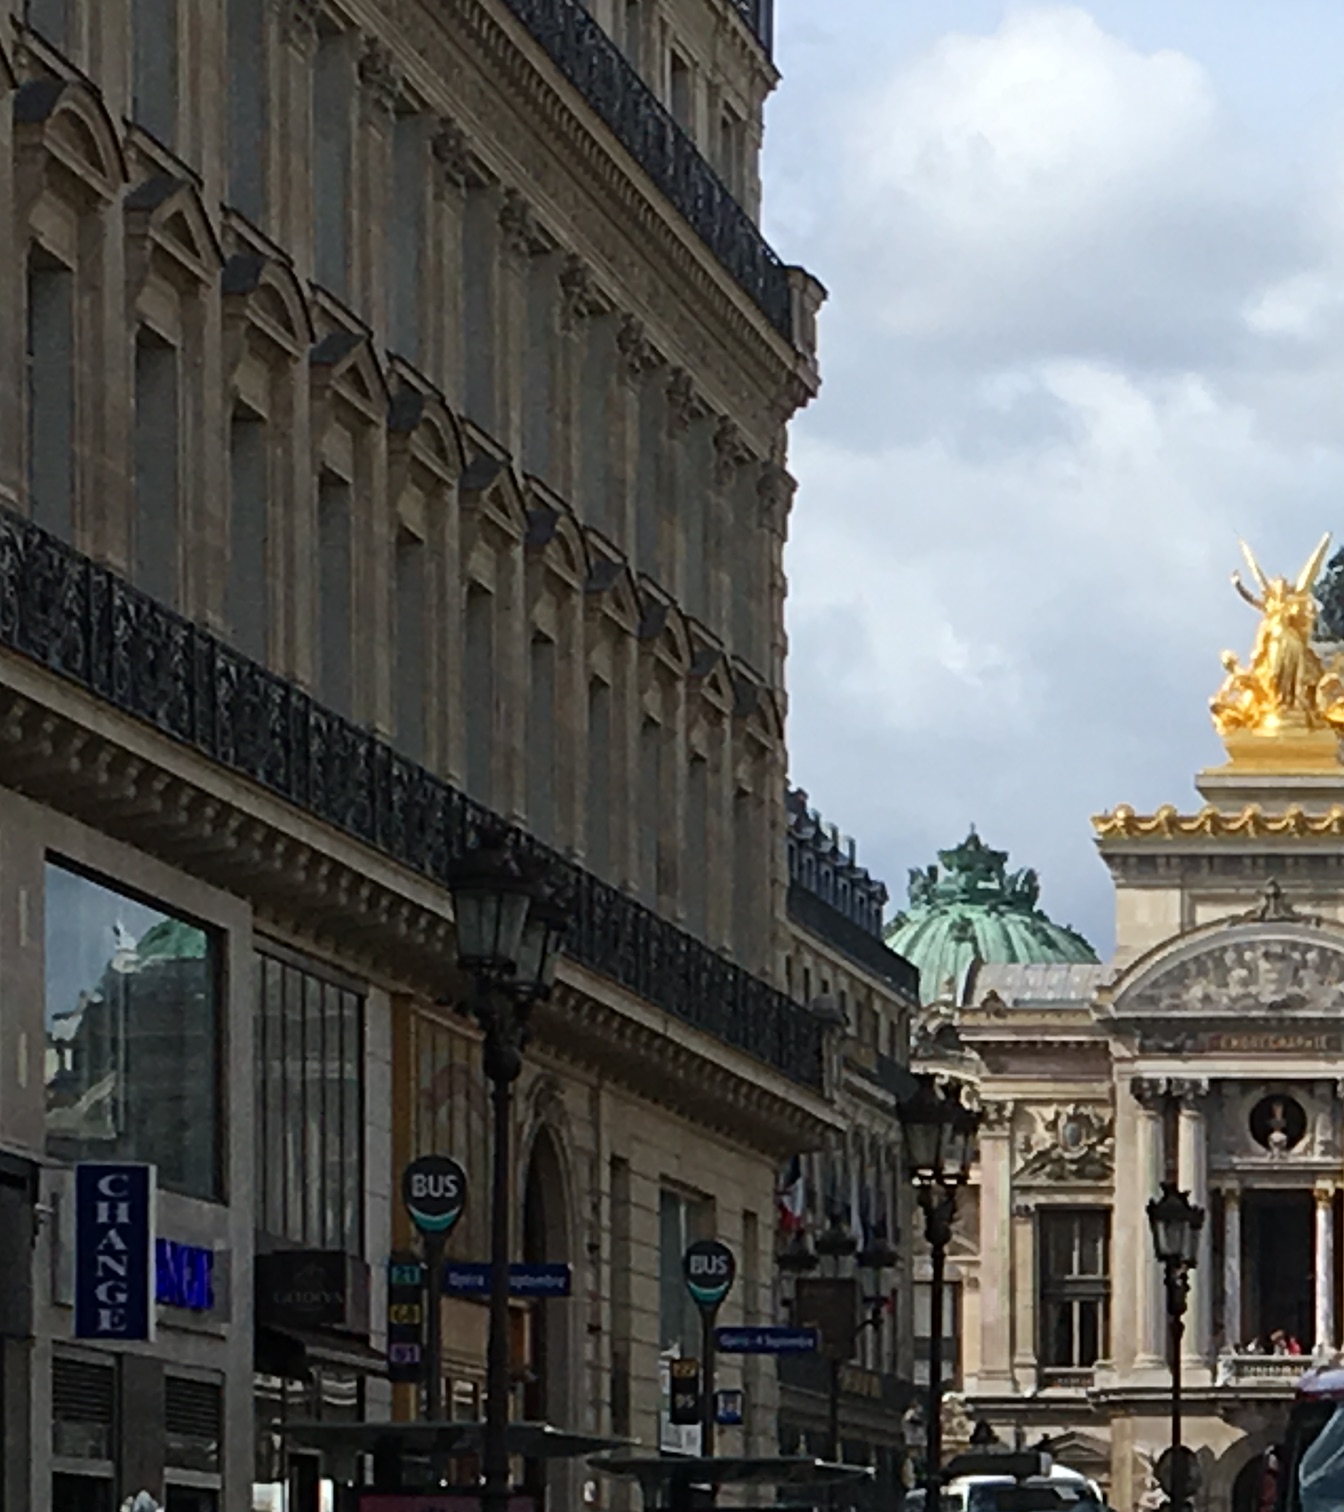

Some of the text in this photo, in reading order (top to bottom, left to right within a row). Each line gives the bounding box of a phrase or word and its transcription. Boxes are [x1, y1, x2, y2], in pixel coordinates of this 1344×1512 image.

[411, 1174, 459, 1199] BUS
[94, 1172, 132, 1333] CHANGE
[689, 1254, 728, 1275] BUS
